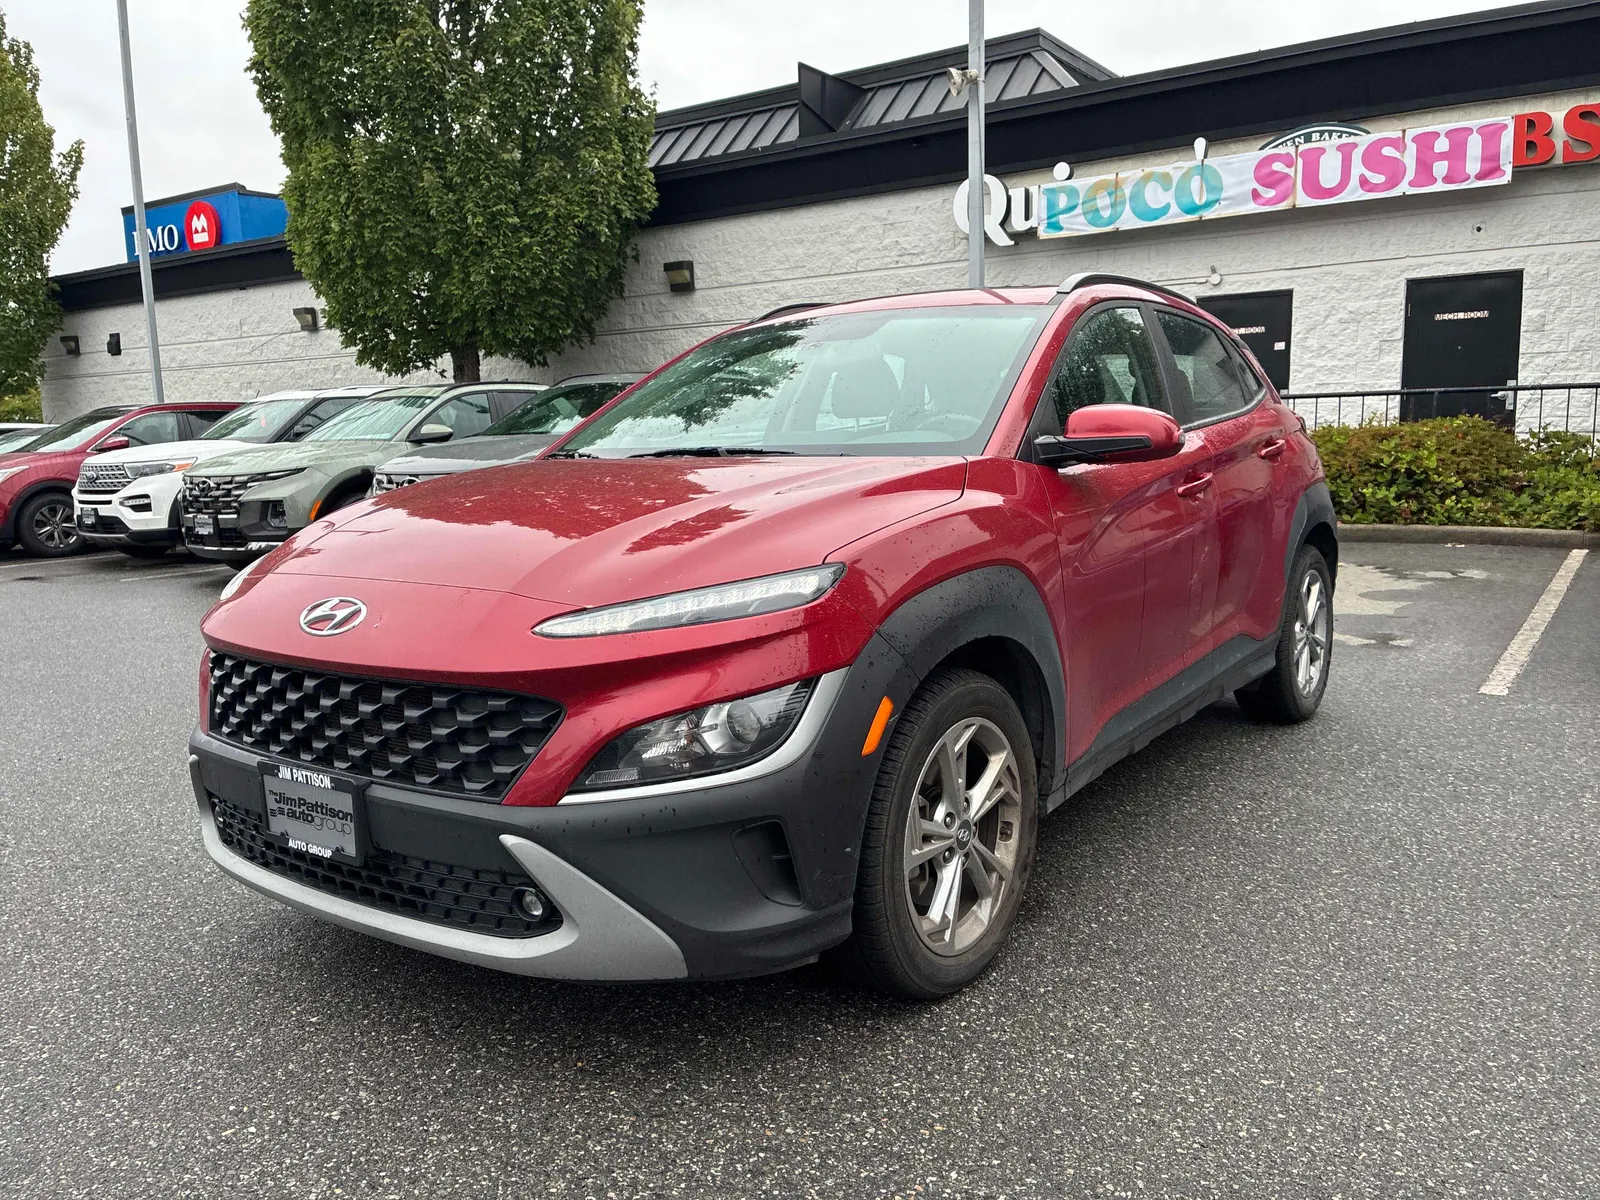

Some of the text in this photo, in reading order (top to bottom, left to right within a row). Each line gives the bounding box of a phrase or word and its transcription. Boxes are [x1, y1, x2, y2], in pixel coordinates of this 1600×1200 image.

[1311, 132, 1355, 141] BAKE
[1042, 122, 1509, 234] POCO SUSHI
[278, 766, 331, 789] JIM PATTISON
[274, 791, 353, 823] Jim Pattison
[288, 838, 333, 859] AUTO GROUP
